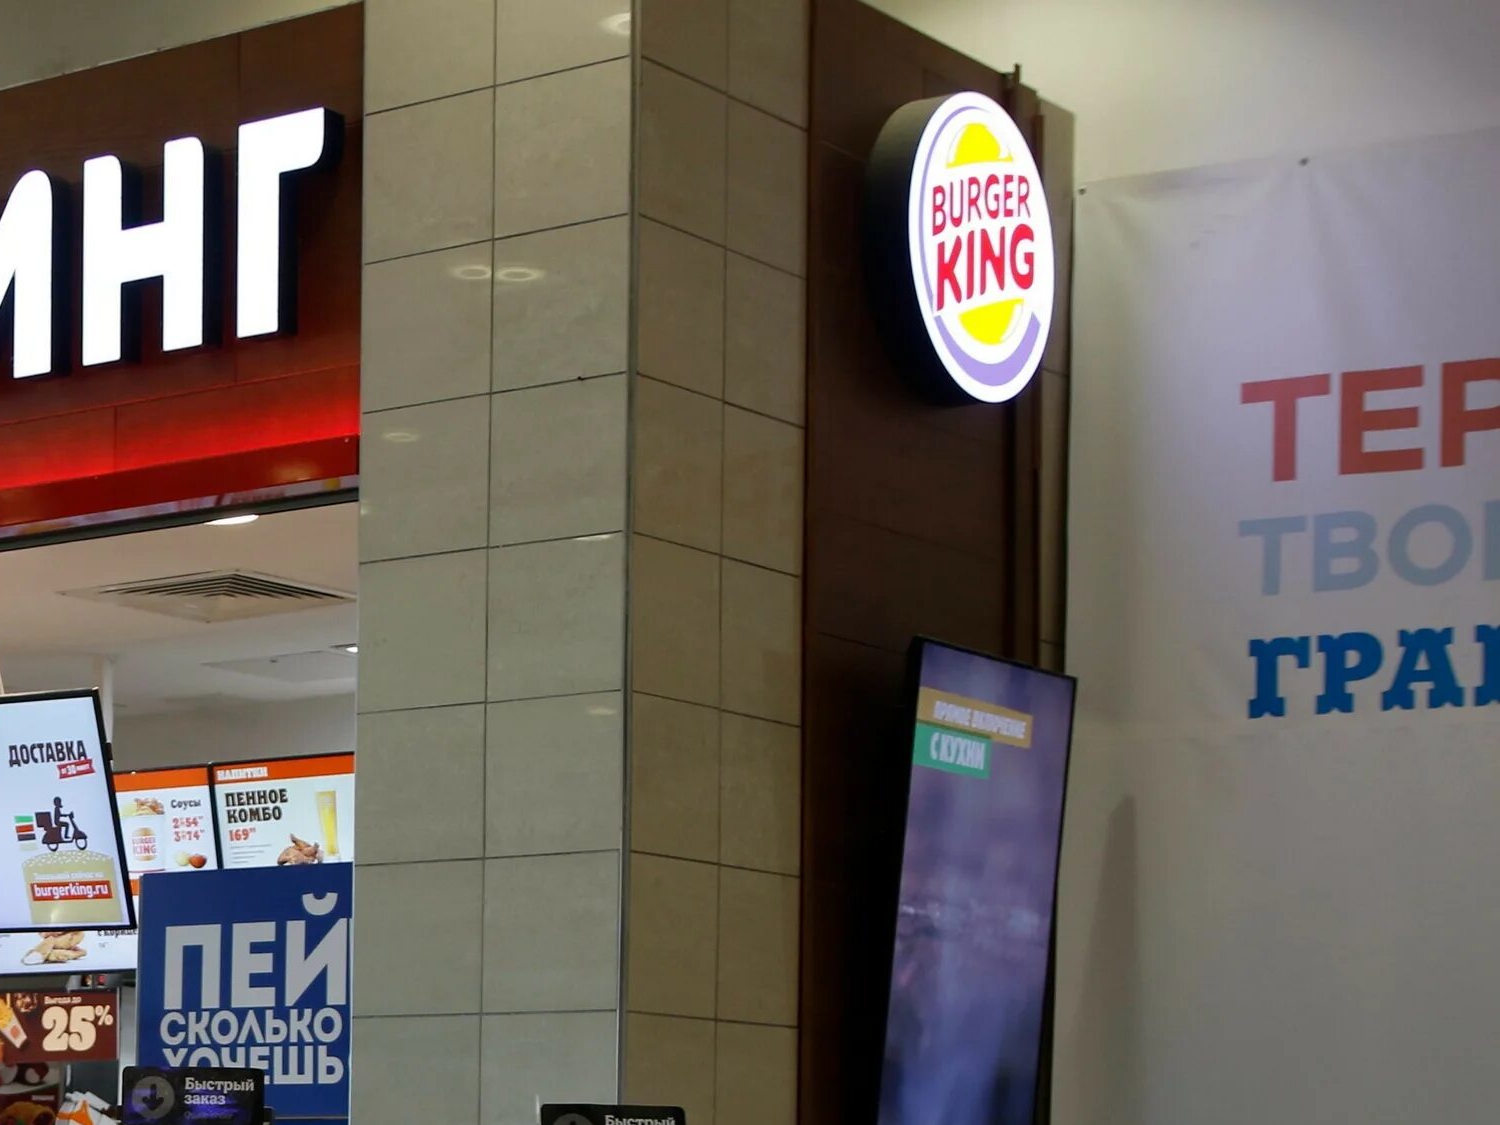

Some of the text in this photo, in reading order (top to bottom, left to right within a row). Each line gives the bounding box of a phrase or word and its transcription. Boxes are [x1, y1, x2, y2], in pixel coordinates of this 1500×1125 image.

[932, 174, 1031, 236] BURGER
[936, 223, 1034, 312] KING
[8, 740, 88, 768] ДОСТАВКА
[171, 799, 202, 810] Соусы
[225, 788, 288, 807] ПЕННОЕ
[227, 806, 282, 824] КОМБО
[33, 882, 109, 899] burgerking.ru
[163, 892, 348, 1010] ПЕЙ
[42, 1005, 114, 1051] 25%
[159, 1008, 343, 1046] СКОЛЬКО
[184, 1077, 255, 1094] Быстрый
[184, 1094, 226, 1106] заказ
